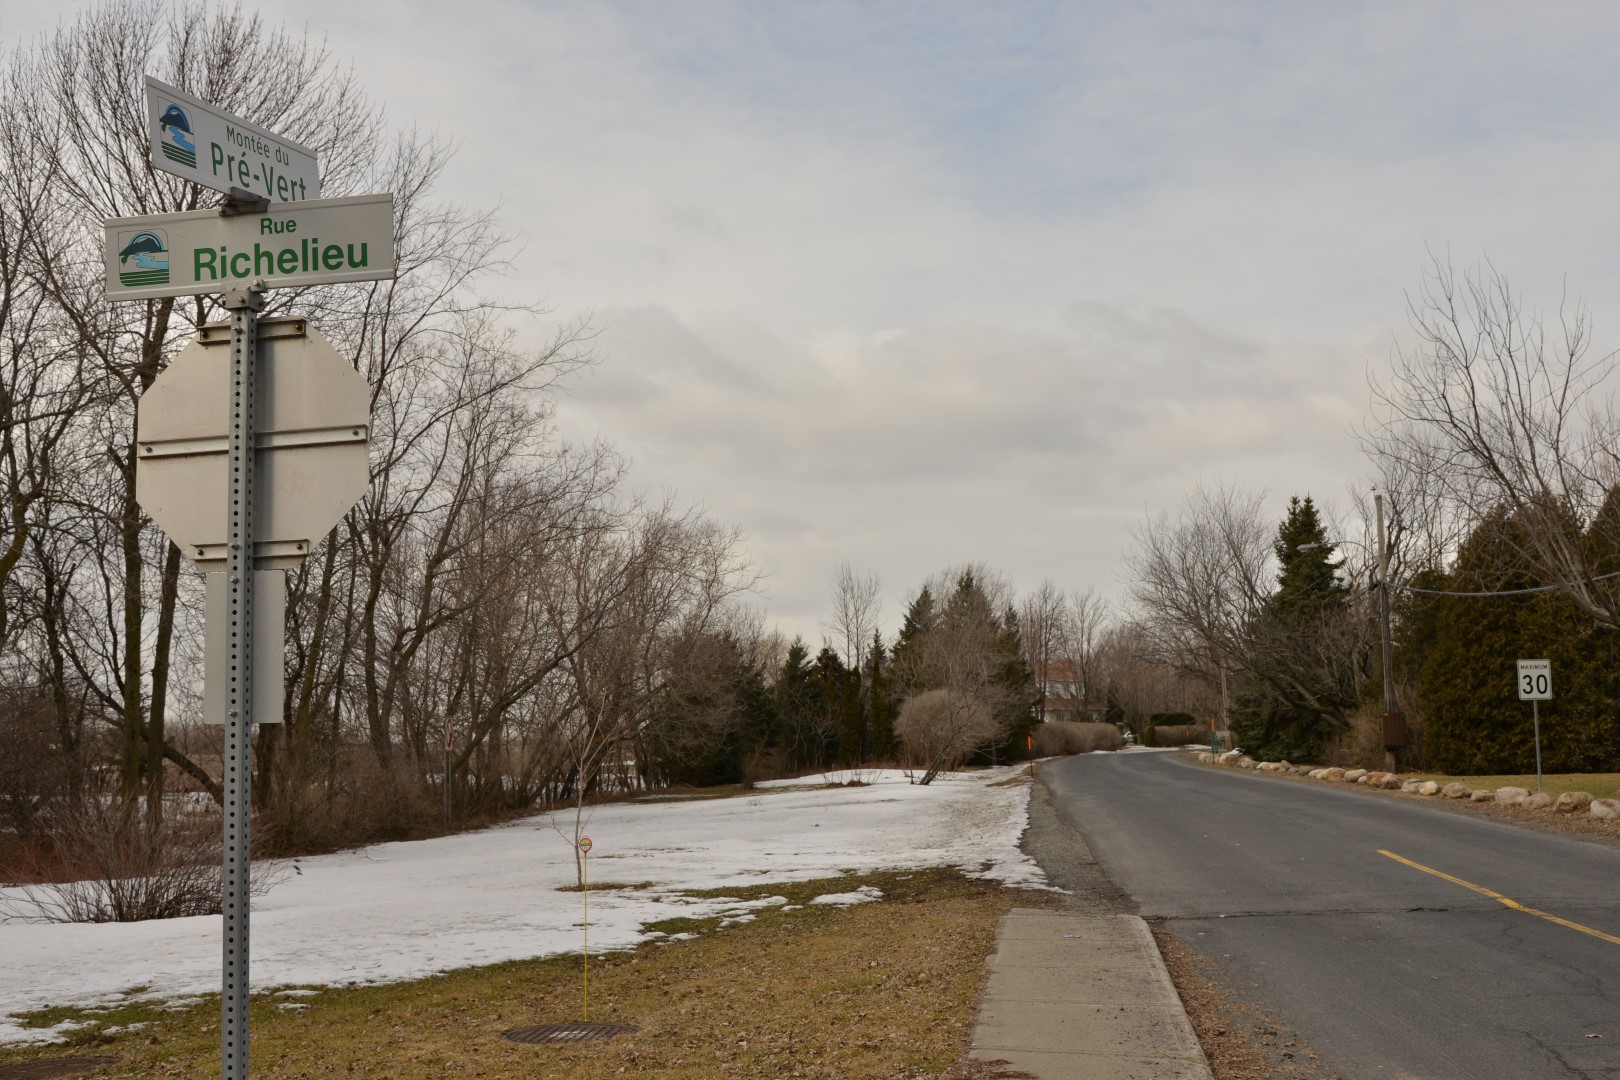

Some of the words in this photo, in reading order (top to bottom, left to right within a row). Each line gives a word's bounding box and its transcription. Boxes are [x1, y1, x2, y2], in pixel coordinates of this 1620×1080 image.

[226, 125, 270, 158] Montée
[275, 149, 289, 166] du
[210, 142, 306, 202] Pré-Vert
[260, 217, 297, 235] Rue
[193, 237, 369, 282] Richelieu
[1522, 674, 1548, 694] 30
